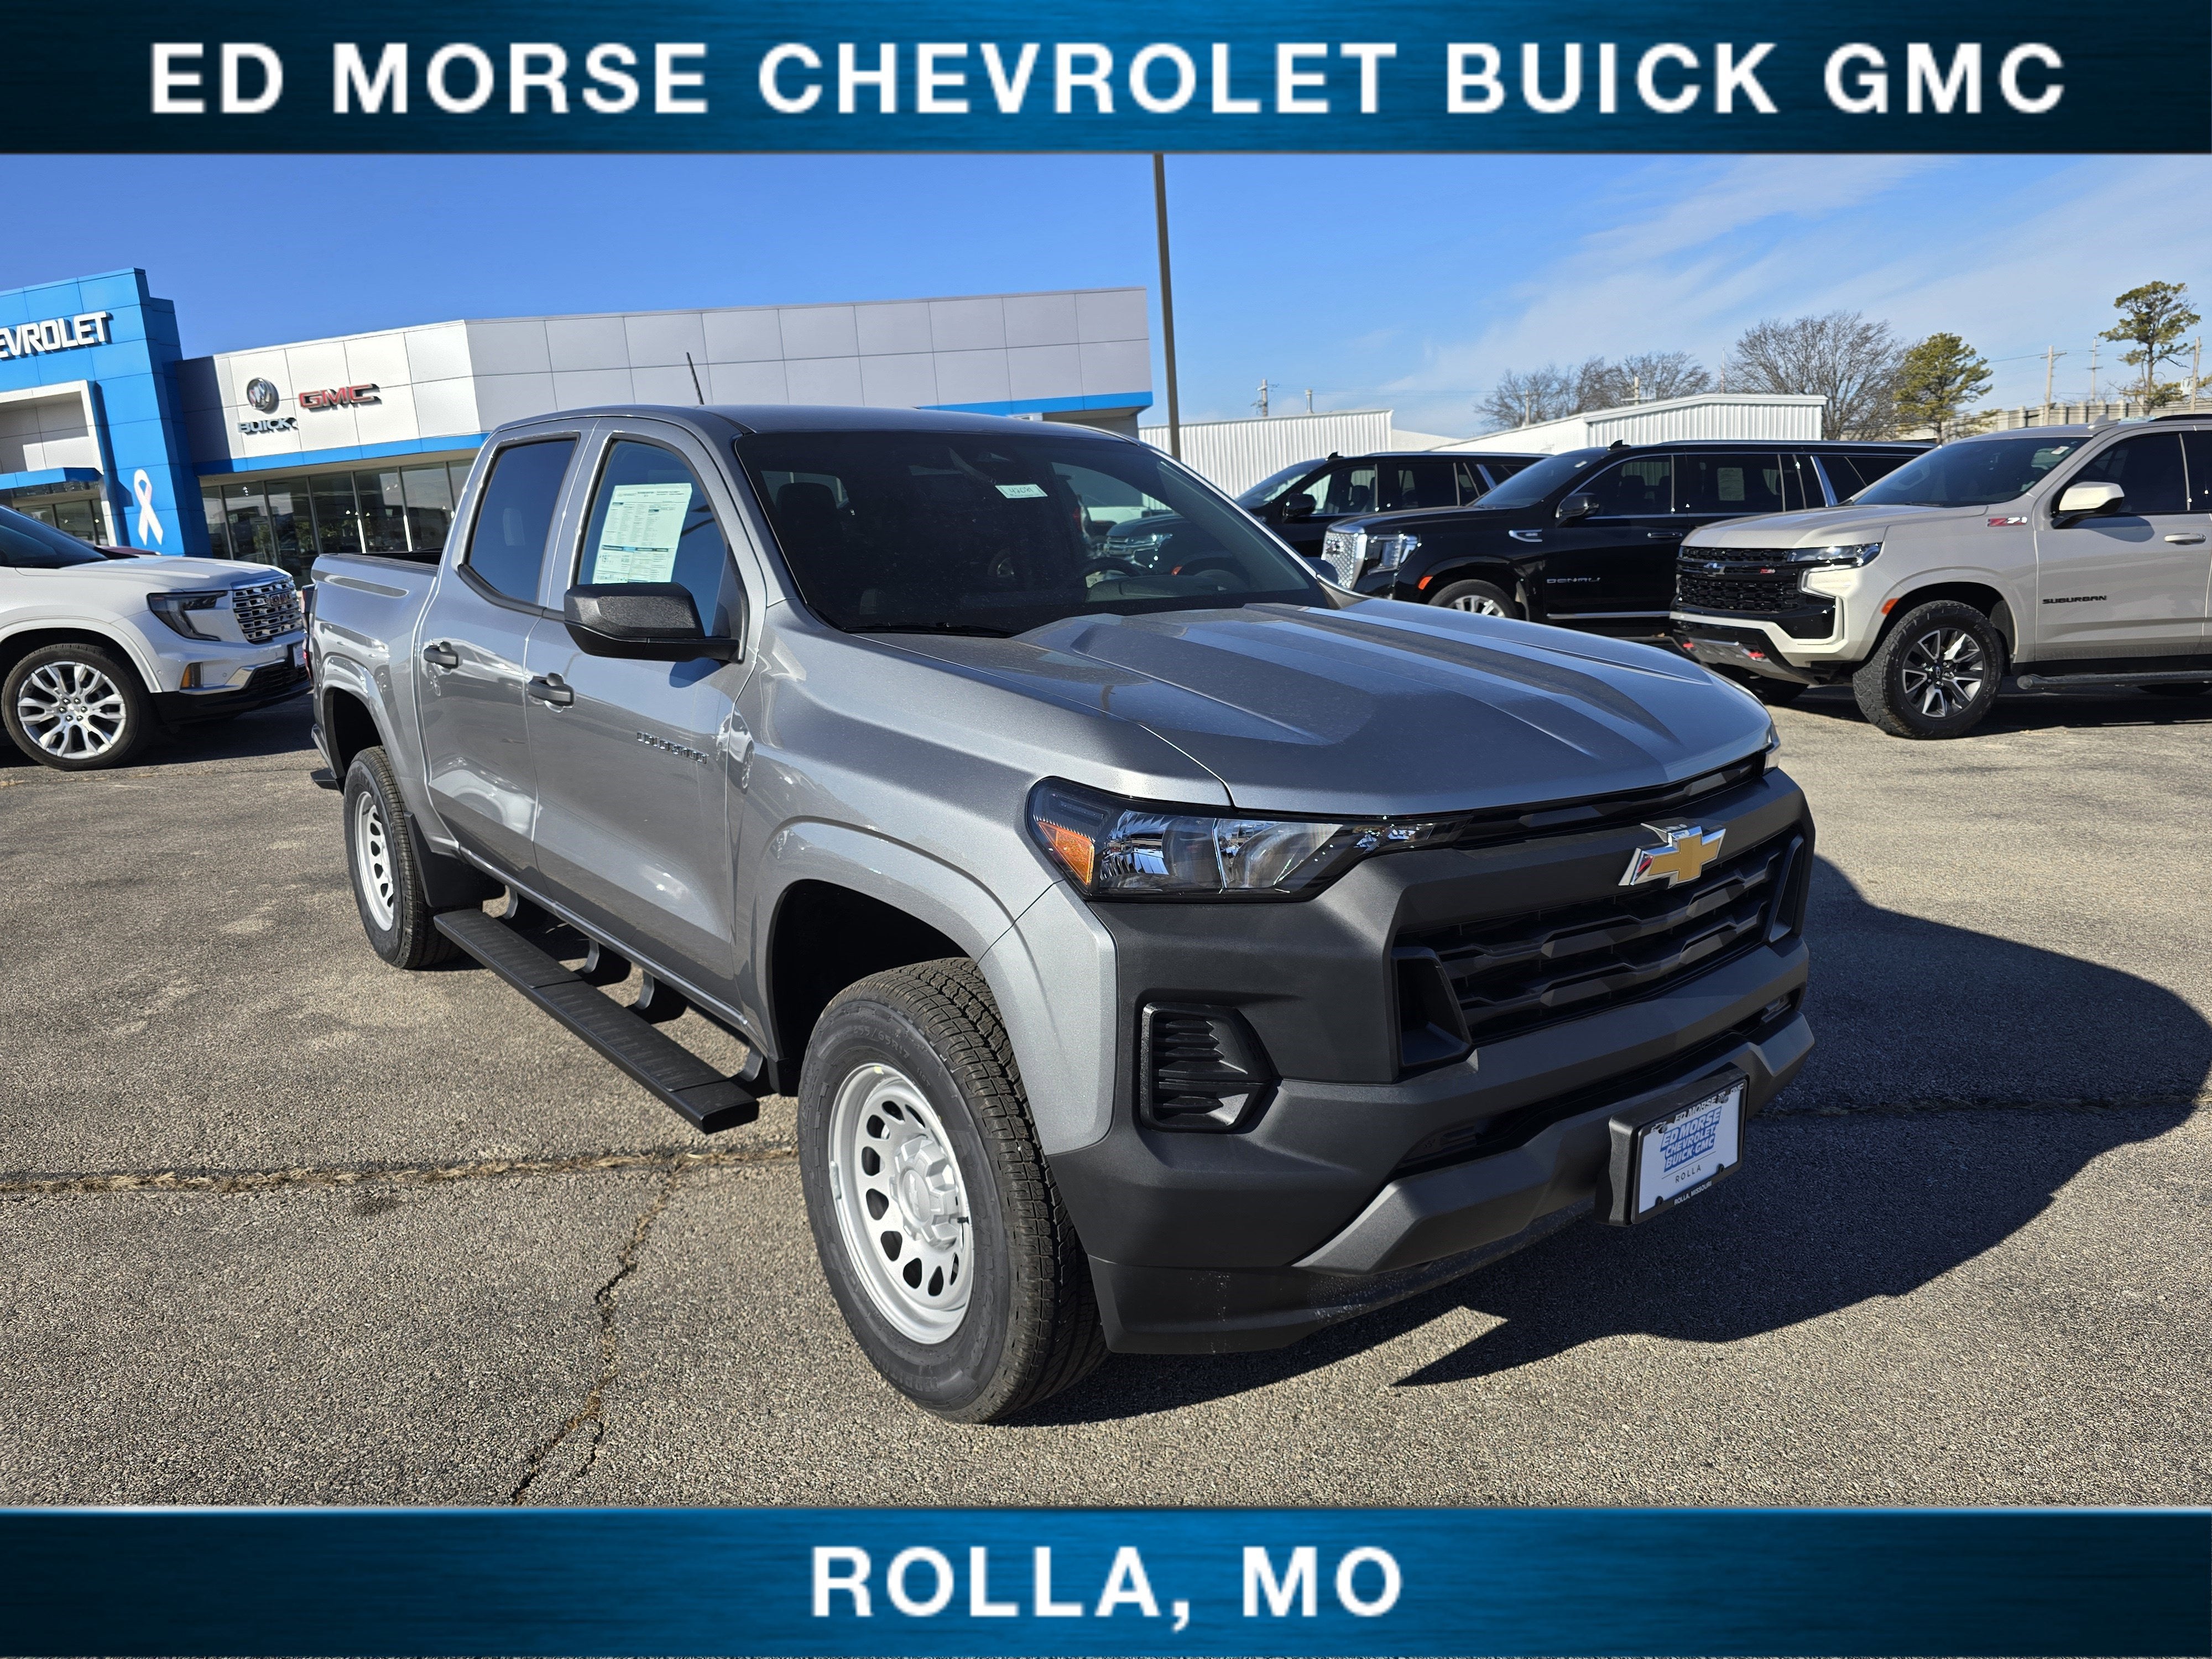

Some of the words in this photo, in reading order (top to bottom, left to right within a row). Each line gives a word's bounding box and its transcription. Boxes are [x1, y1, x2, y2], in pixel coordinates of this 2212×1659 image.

[299, 384, 375, 409] GMC
[238, 418, 291, 434] BUICK
[1987, 517, 2028, 527] Z71
[2042, 596, 2107, 604] SUBURBAN
[1661, 1127, 1679, 1149] ED
[1679, 1108, 1721, 1139] MORSE
[1665, 1126, 1715, 1158] CHEVROLET
[1675, 1164, 1702, 1183] ROLLA
